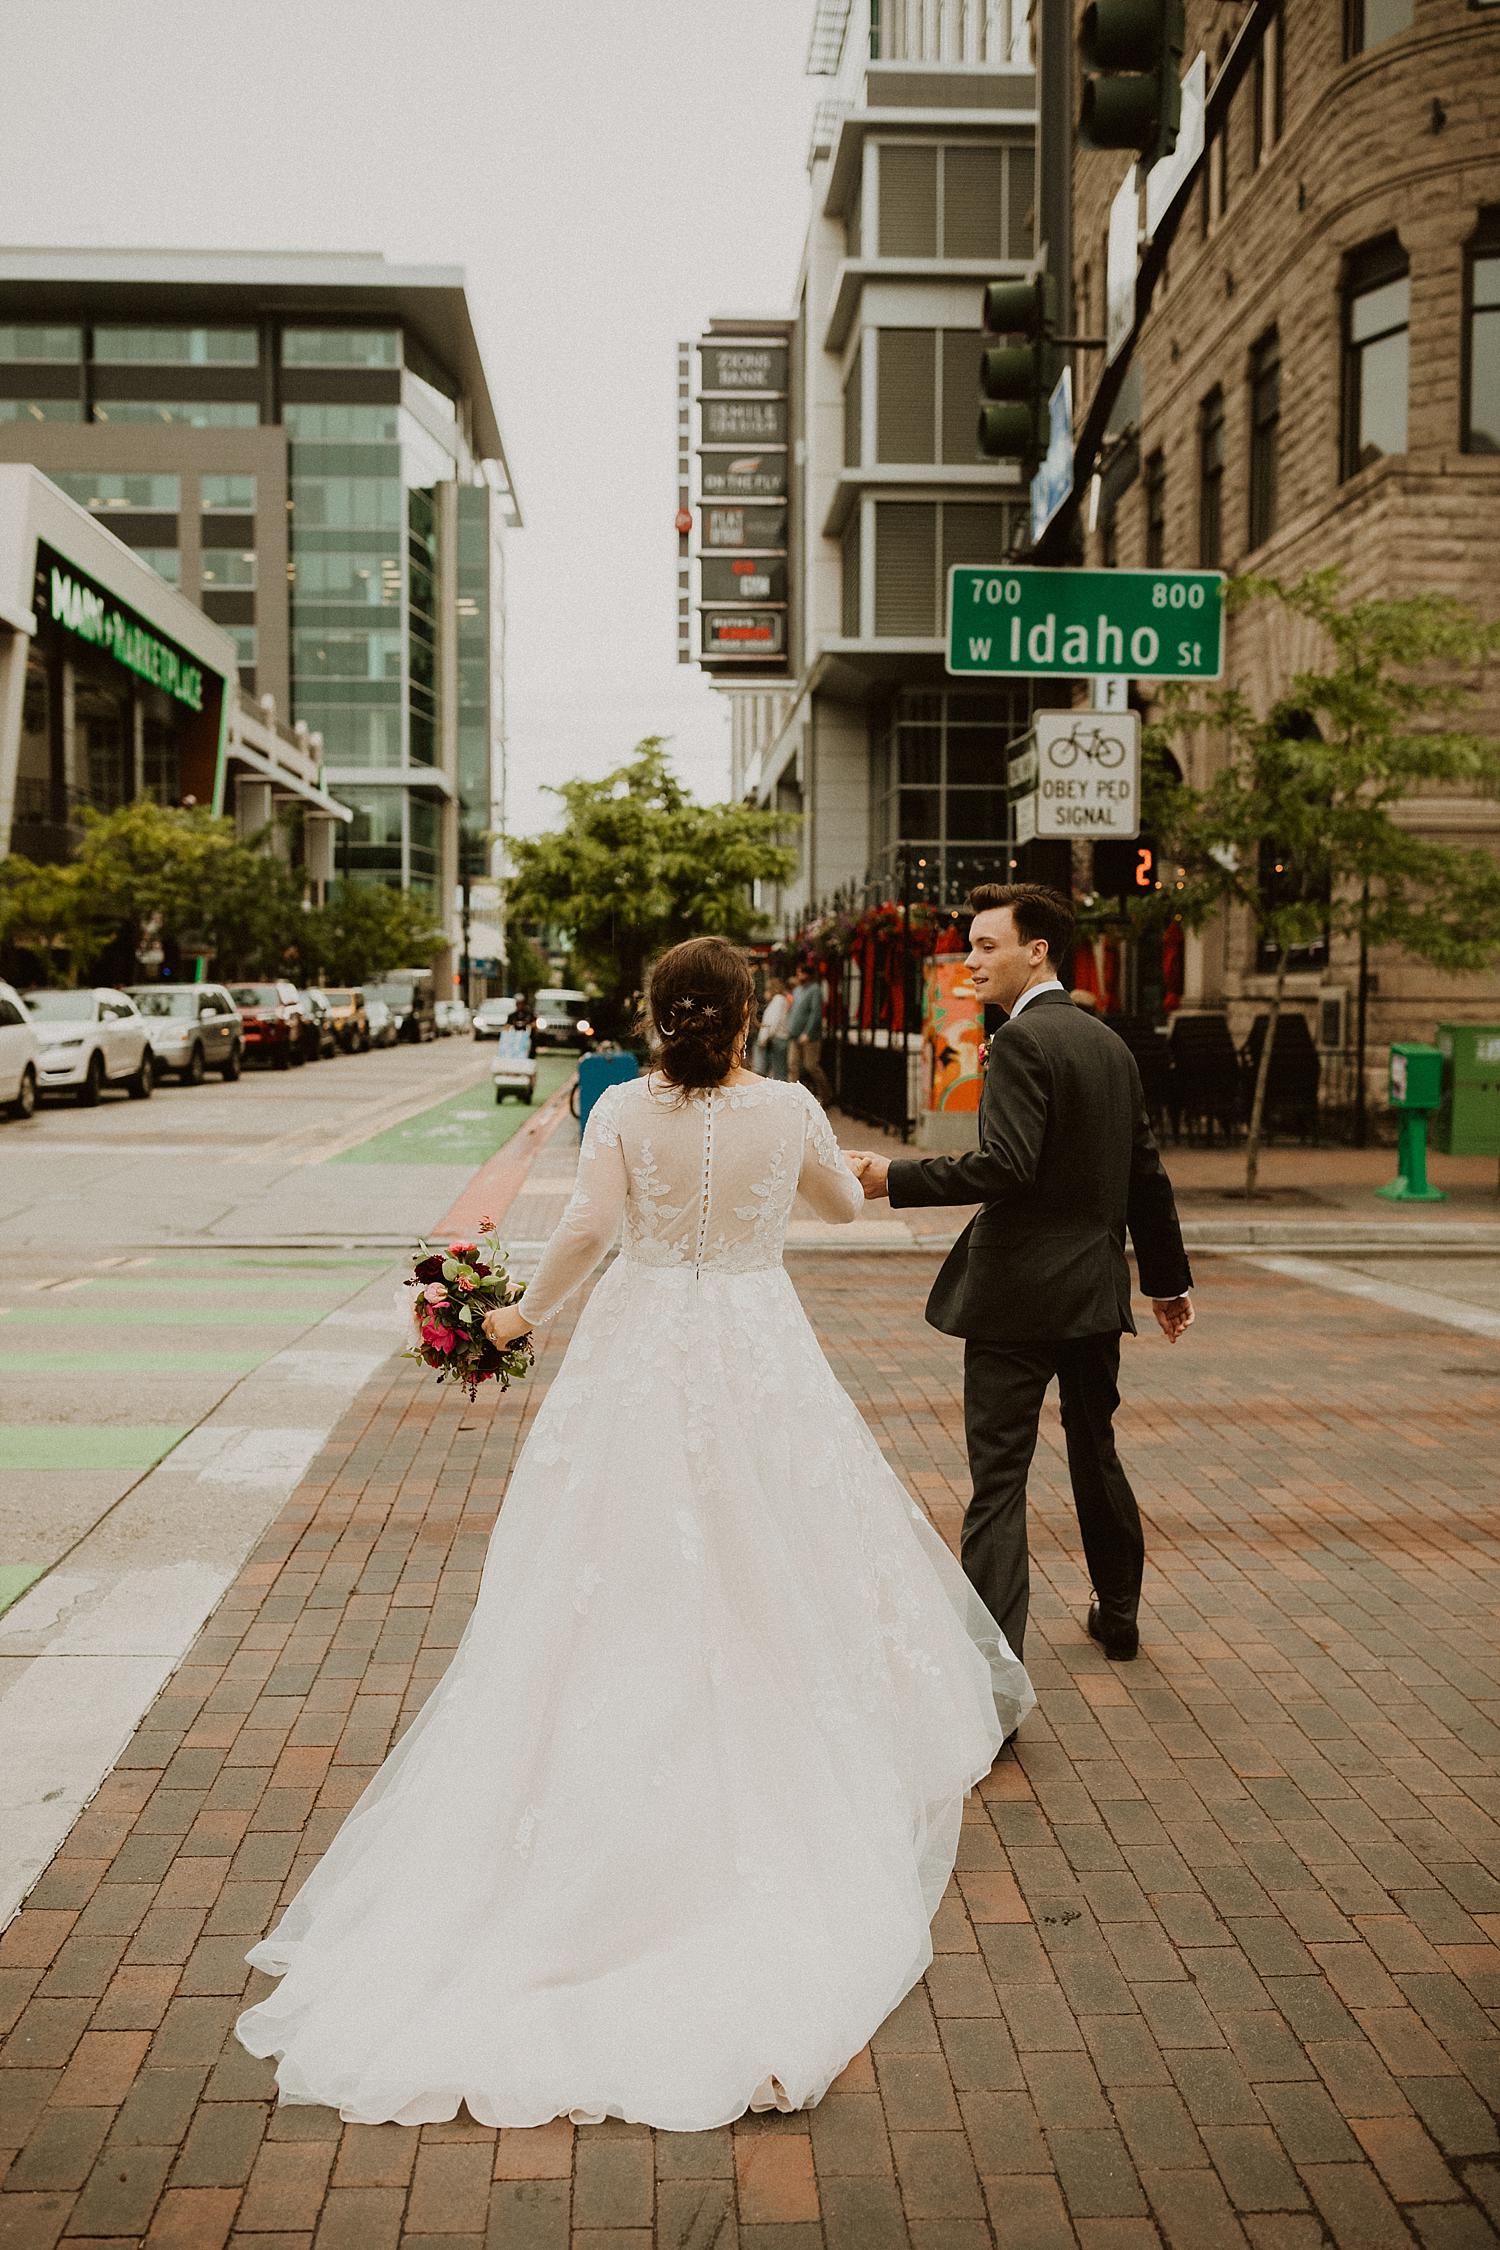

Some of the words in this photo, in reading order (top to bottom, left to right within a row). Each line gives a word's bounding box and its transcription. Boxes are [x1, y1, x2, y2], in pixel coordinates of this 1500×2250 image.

[971, 578, 1021, 605] 700
[1152, 582, 1205, 609] 800
[969, 636, 992, 662] W
[1010, 613, 1160, 667] Idaho
[1178, 641, 1203, 667] St
[112, 609, 204, 713] MARKETPLACE
[1042, 779, 1088, 800] OBEY
[1097, 780, 1131, 801] PED
[1056, 805, 1116, 827] SIGNAL
[1135, 848, 1152, 886] 2
